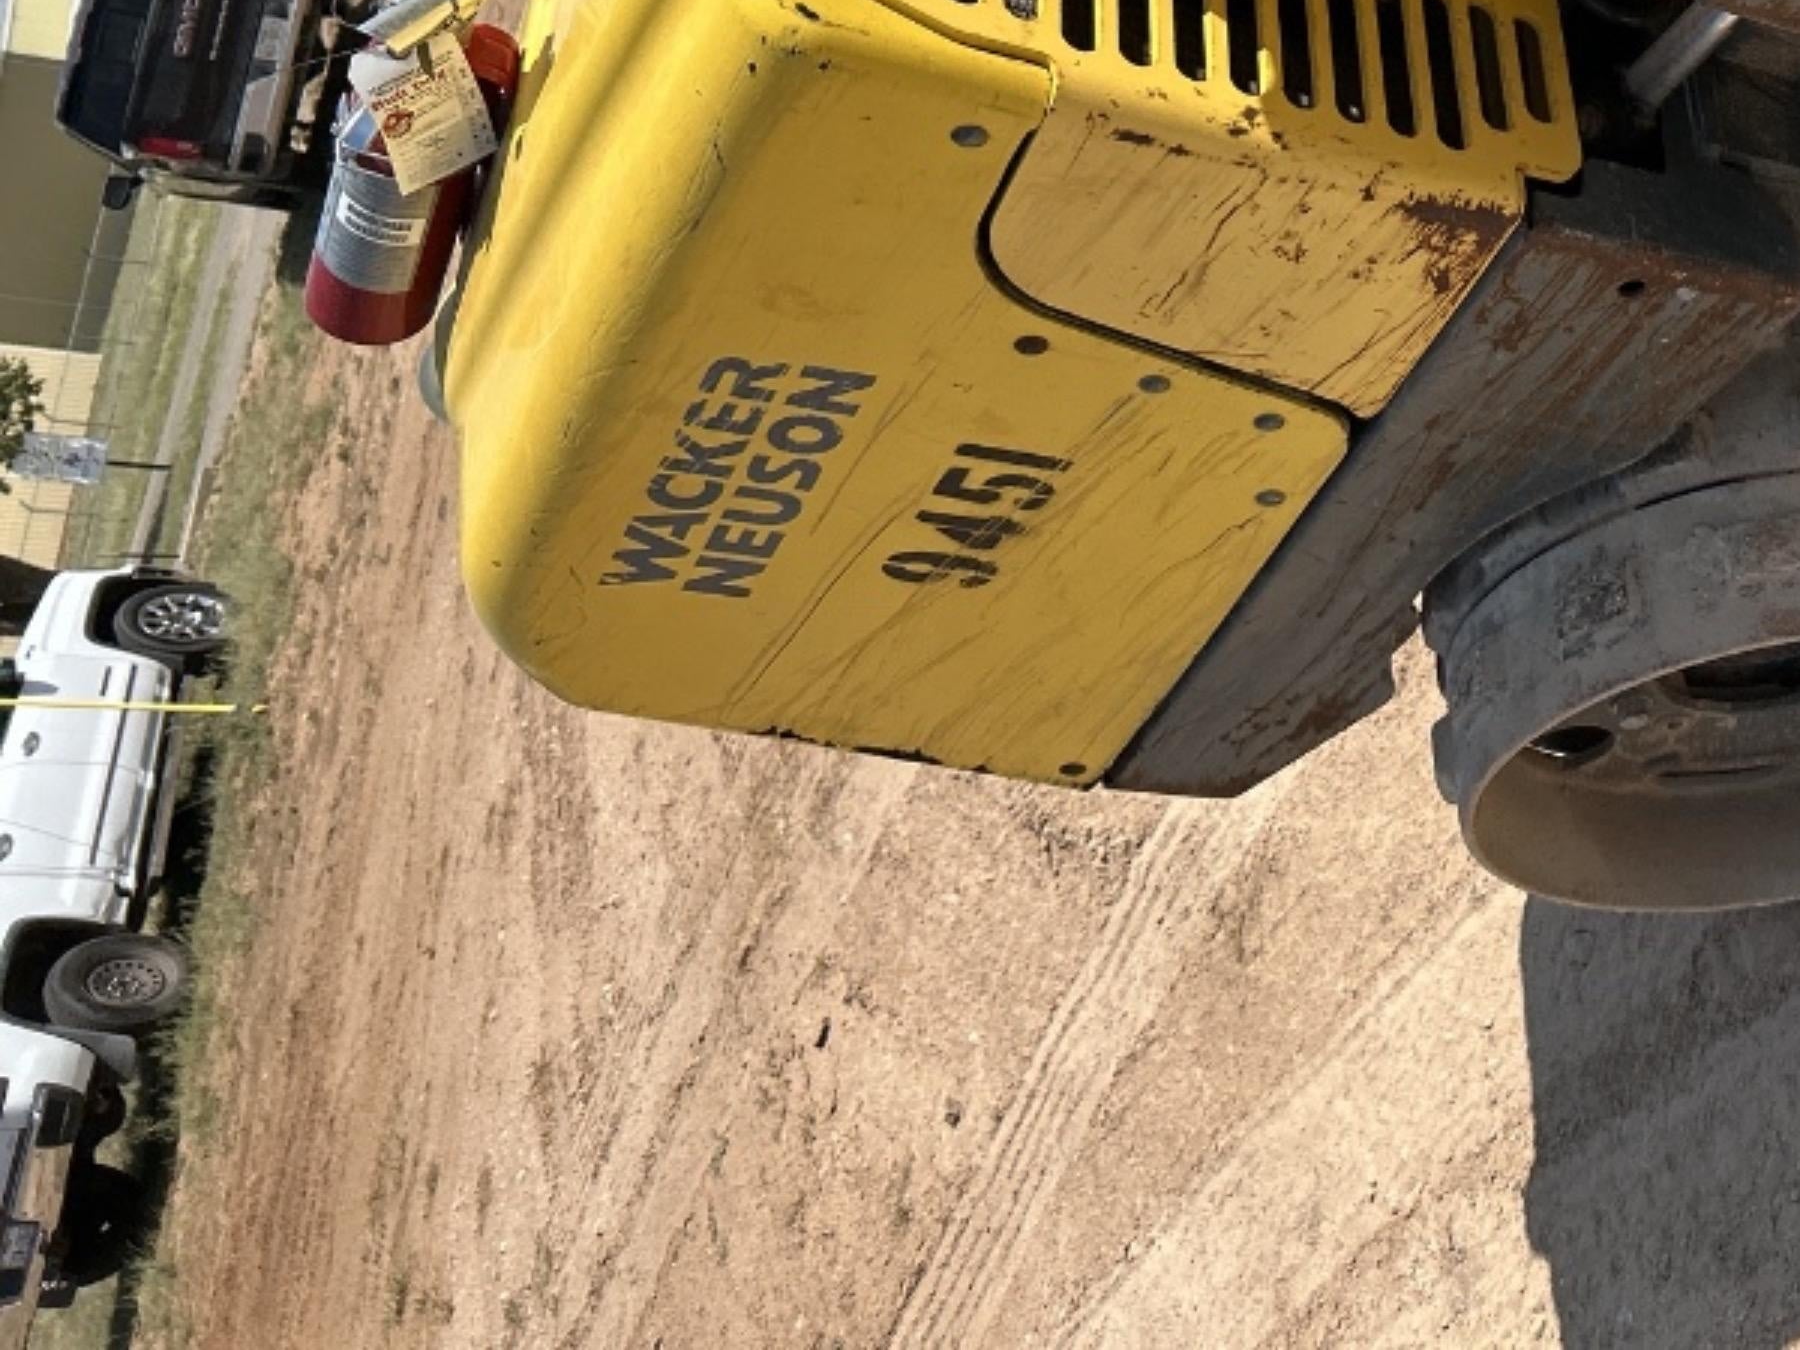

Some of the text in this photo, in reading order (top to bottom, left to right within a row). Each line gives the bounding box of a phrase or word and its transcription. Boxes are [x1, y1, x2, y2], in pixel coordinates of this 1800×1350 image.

[597, 356, 792, 587] WACKER
[682, 363, 878, 599] NEUSON
[881, 443, 1075, 588] 9451
